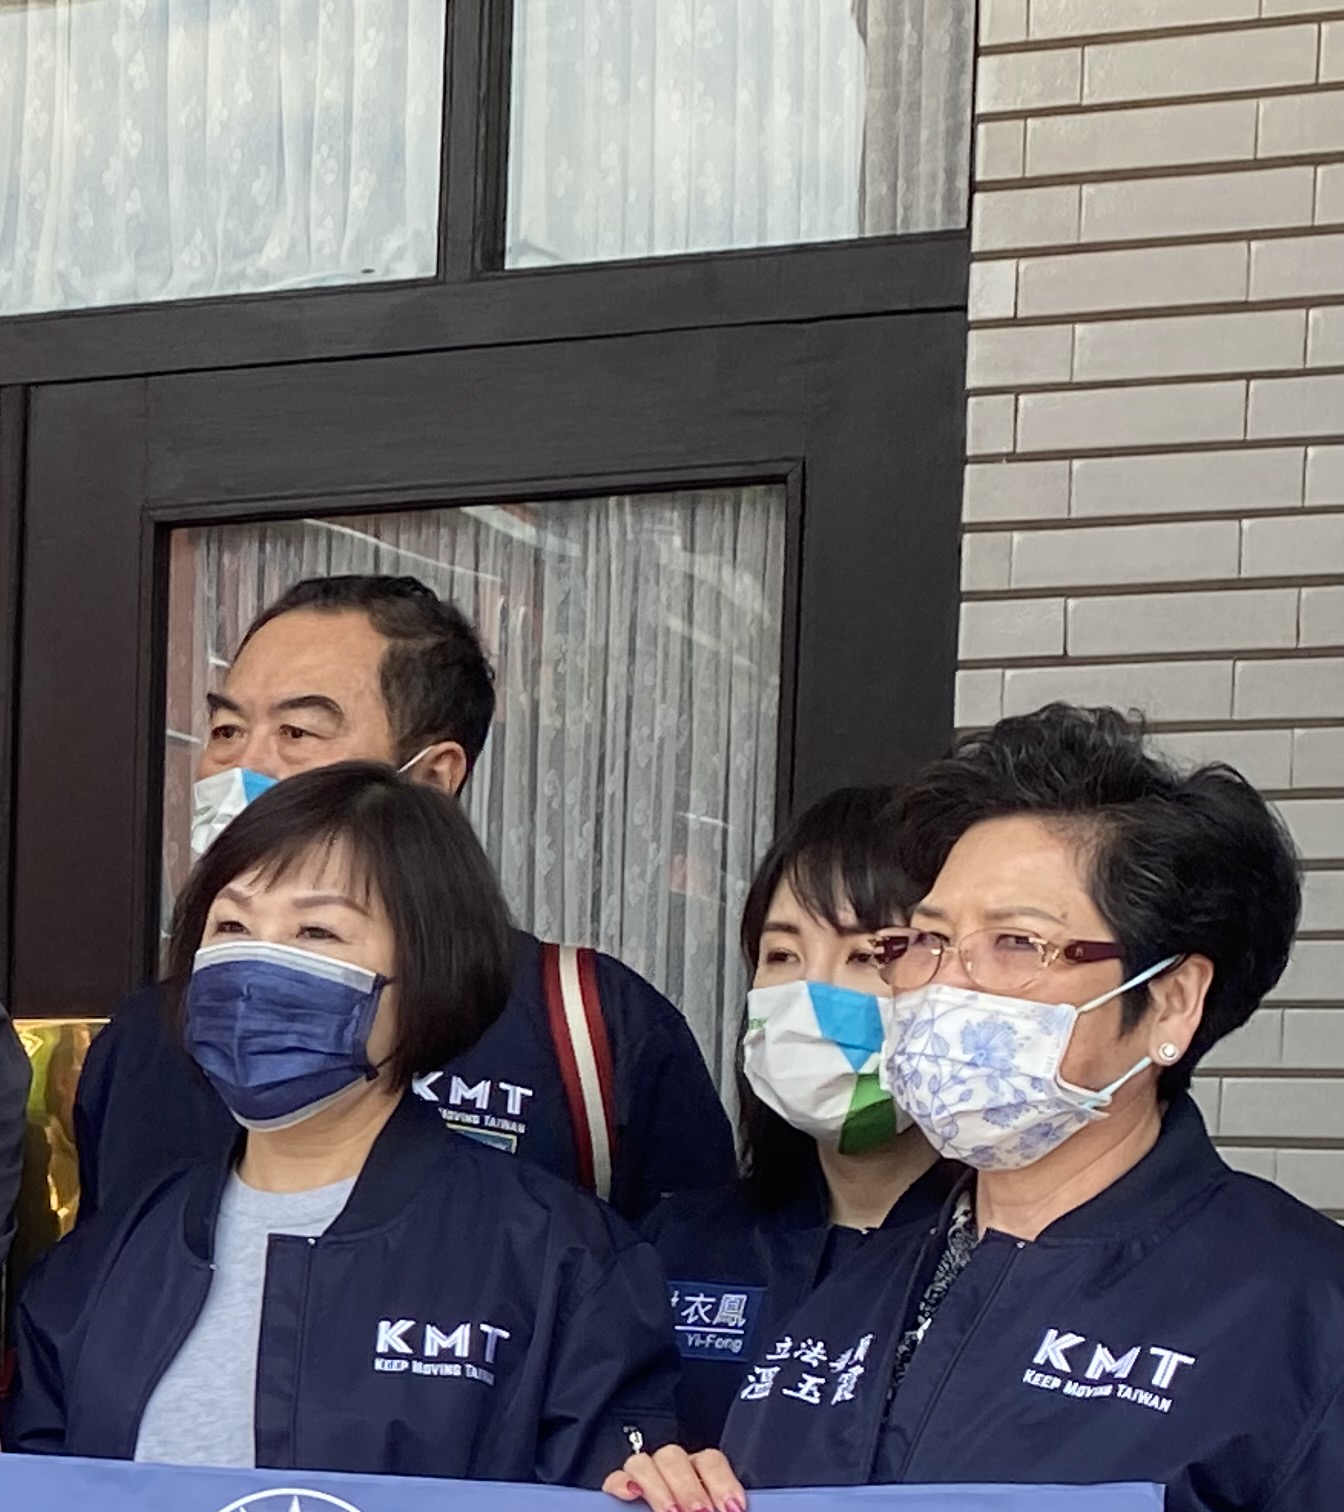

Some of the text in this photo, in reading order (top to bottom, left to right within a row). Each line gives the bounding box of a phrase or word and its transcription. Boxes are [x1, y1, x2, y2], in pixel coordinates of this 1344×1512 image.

[412, 1071, 533, 1115] KMT
[671, 1290, 748, 1327] 衣鳳
[376, 1319, 511, 1364] KMT
[1032, 1328, 1196, 1389] KMT
[1022, 1368, 1062, 1389] KEEP
[1116, 1383, 1173, 1413] TAIWAN
